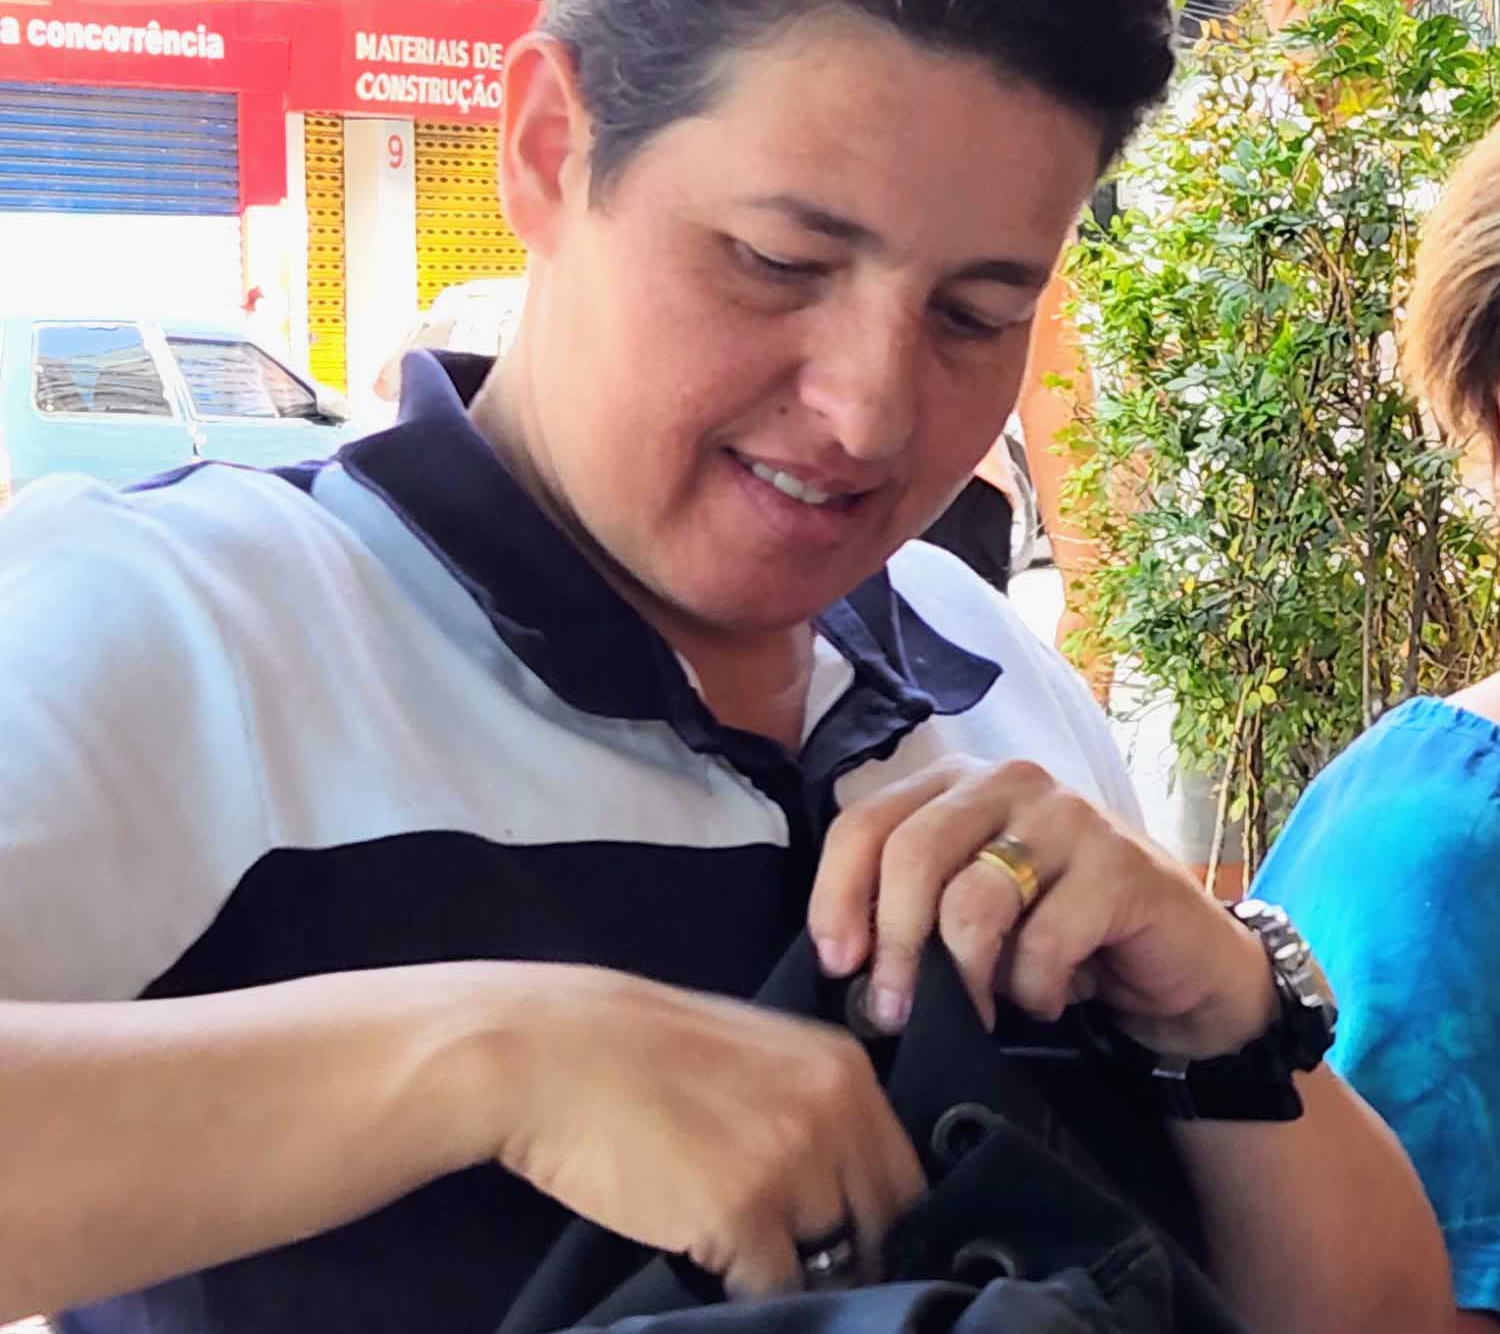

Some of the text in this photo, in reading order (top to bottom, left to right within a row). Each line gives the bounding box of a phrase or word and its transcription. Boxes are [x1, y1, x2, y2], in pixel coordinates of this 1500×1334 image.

[26, 18, 225, 60] concorrência
[355, 31, 504, 71] MATERIAIS DE
[355, 71, 503, 114] CONSTRUÇÃO
[387, 133, 404, 169] 9
